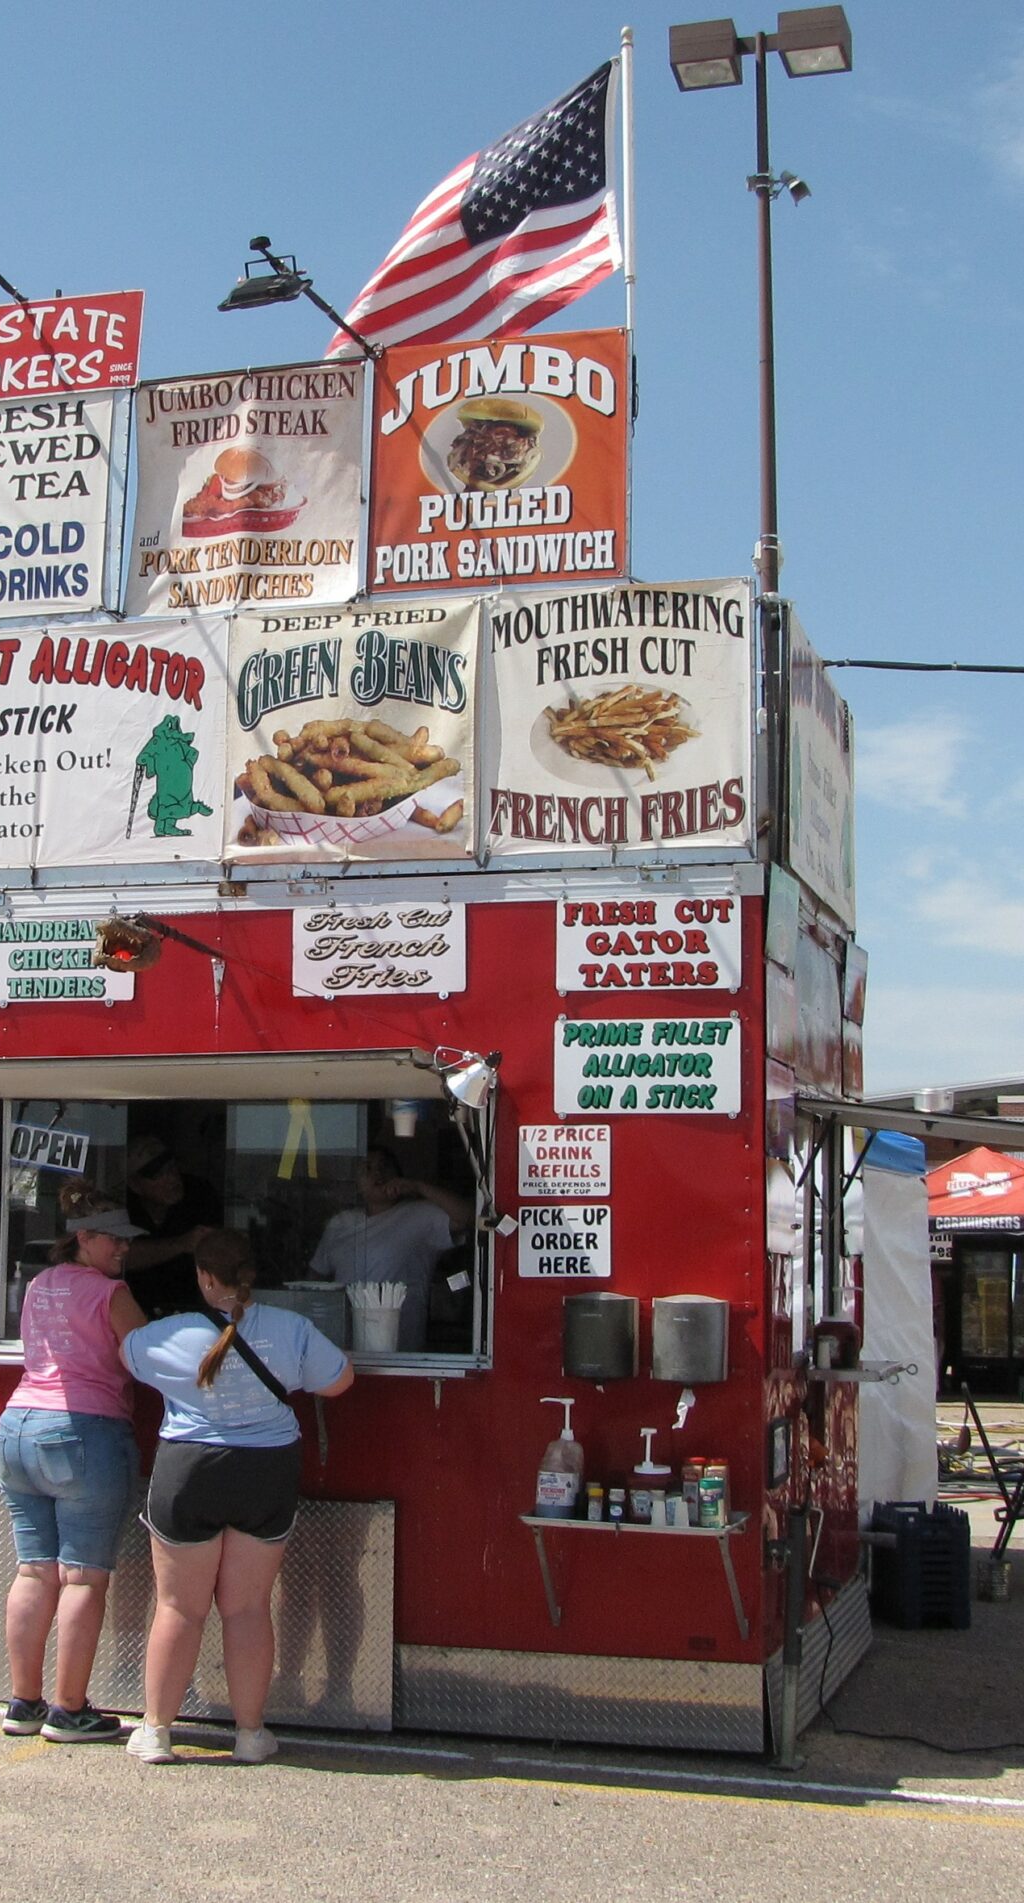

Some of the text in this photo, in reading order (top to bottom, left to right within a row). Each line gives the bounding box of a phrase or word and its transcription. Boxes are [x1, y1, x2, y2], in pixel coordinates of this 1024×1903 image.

[109, 363, 133, 372] SINCE
[145, 370, 357, 424] JUMBO CHICKEN
[381, 344, 616, 436] JUMBO
[171, 408, 328, 448] FRIED STEAK
[8, 470, 90, 501] TEA
[418, 485, 573, 534] PULLED
[139, 532, 160, 547] and
[138, 538, 353, 578] PORK TENDERLOIN
[374, 530, 615, 585] PORK SANDWICH
[167, 572, 314, 609] SANDWICHES
[261, 607, 447, 634] DEEP FRIED
[490, 590, 744, 653] MOUTHWATERING
[29, 636, 206, 712] ALLIGATOR
[536, 635, 697, 686] FRESH CUT
[237, 629, 468, 731] GREEN BEANS
[57, 748, 112, 772] Out!
[0, 787, 37, 807] the
[490, 787, 629, 845] FRENCH
[639, 776, 745, 842] FRIES
[303, 909, 452, 931] Fresh Cut
[563, 899, 734, 926] FRESH CUT
[304, 933, 451, 961] French
[586, 930, 710, 956] GATOR
[7, 976, 106, 999] TENDERS
[322, 963, 432, 989] Fries
[579, 961, 718, 988] TATERS
[562, 1021, 732, 1047] PRIME FILLET
[582, 1053, 713, 1078] ALLIGATOR
[577, 1084, 717, 1109] ON A STICK
[10, 1126, 83, 1169] OPEN
[522, 1128, 607, 1143] 1/2 PRICE
[536, 1147, 593, 1160] DRINK
[528, 1164, 601, 1178] REFILLS
[936, 1216, 1021, 1230] CORNHUSKERS
[531, 1233, 598, 1250] ORDER
[539, 1257, 591, 1274] HERE
